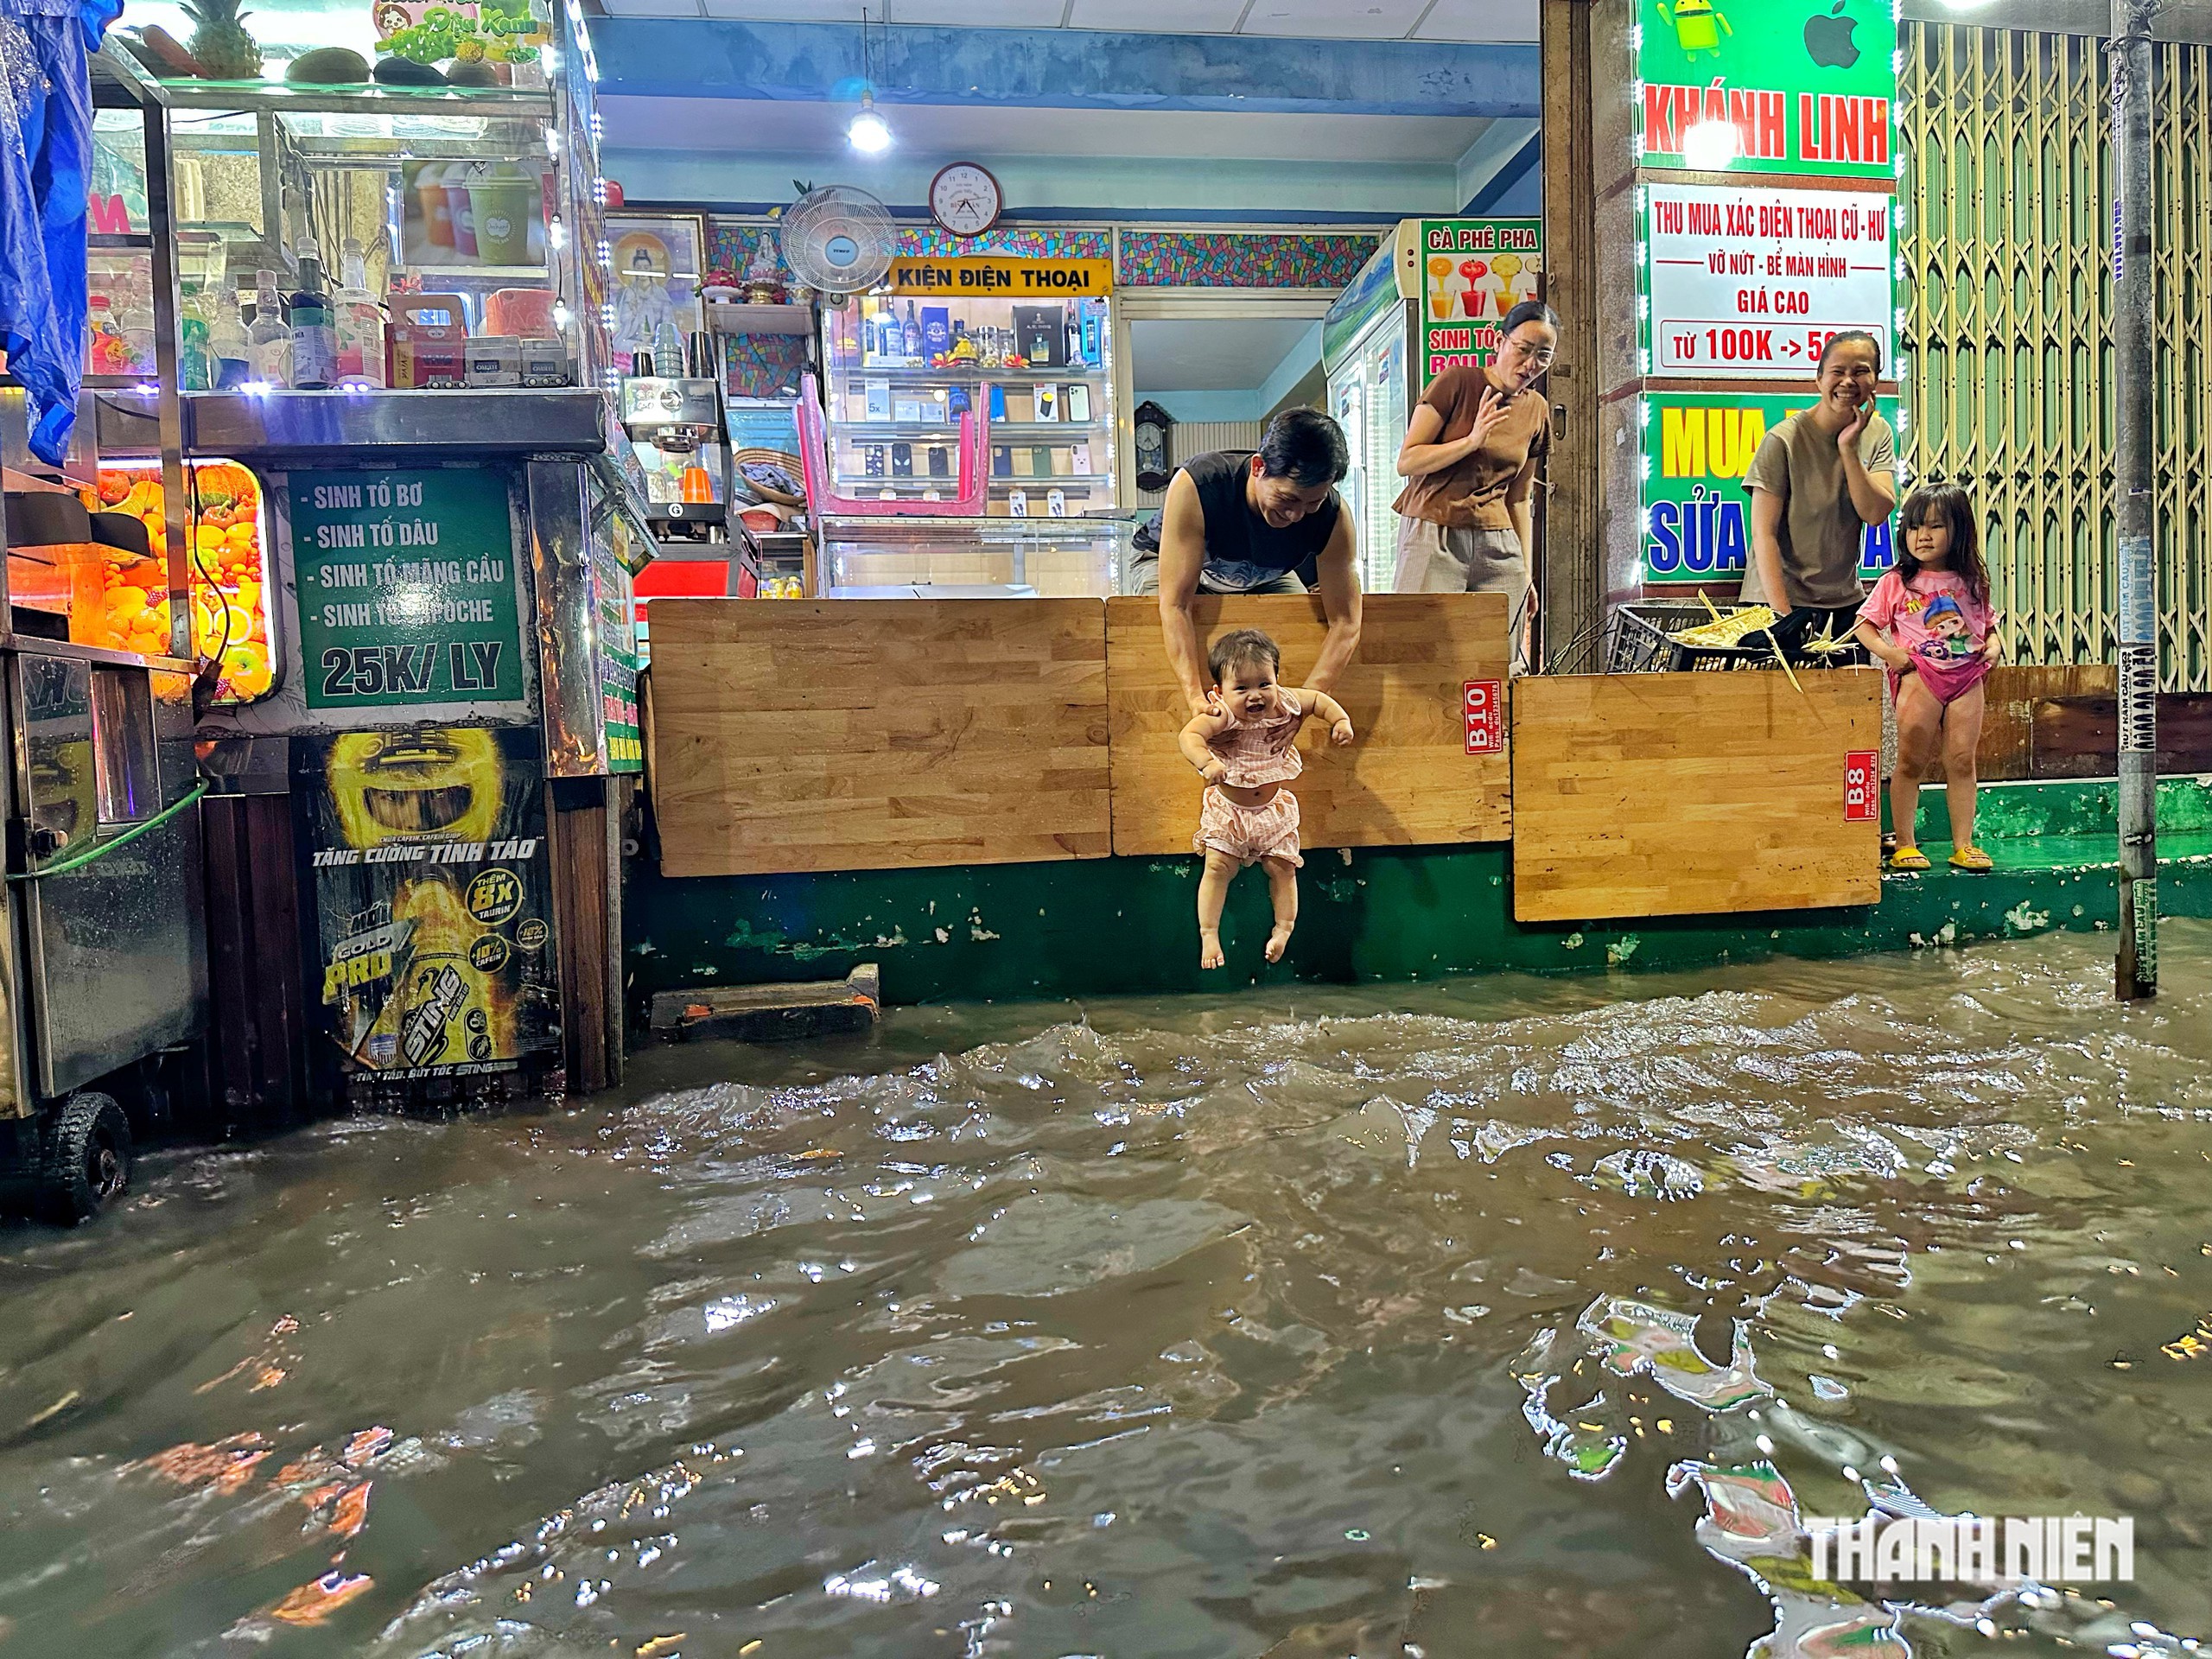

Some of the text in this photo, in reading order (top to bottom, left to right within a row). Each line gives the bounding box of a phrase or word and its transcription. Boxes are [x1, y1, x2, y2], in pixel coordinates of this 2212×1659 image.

[481, 8, 538, 37] Xanh
[1643, 76, 1890, 166] KHÁNH LINH
[1655, 198, 1885, 245] THU MUA XÁC ĐIỆN THOẠI CŨ HƯ
[1428, 226, 1538, 250] CÀ PHÊ PHA
[1708, 247, 1847, 277] VỠ NỨT BỂ MÀN HÌNH
[898, 264, 951, 291] KIỆN
[959, 264, 1011, 292] ĐIỆN
[1020, 269, 1090, 292] THOẠI
[1737, 286, 1809, 314] GIÁ CAO
[1429, 321, 1496, 350] SINH TỐ
[1674, 332, 1696, 359] TỪ
[1706, 328, 1772, 360] 100K
[868, 403, 880, 413] 5x
[1661, 407, 1766, 479] MUA
[315, 477, 423, 509] SINH TỐ BƠ
[317, 515, 439, 549] SINH TỐ DÂU
[1647, 484, 1747, 574] SỬA
[321, 564, 367, 588] SINH
[372, 555, 396, 586] TỐ
[466, 552, 505, 583] CẦU
[324, 603, 371, 627] SINH
[322, 641, 503, 696] 25K/ LY
[1467, 689, 1487, 747] B10
[1848, 768, 1865, 804] B8
[313, 836, 537, 867] TĂNG CƯỜNG TỈNH TÁO
[472, 880, 515, 912] 8X
[476, 874, 506, 887] THÊM
[480, 905, 511, 918] TAURIN
[338, 936, 392, 958] GOLD
[476, 954, 501, 967] CAFEIN
[405, 969, 461, 1062] STING
[433, 1064, 454, 1076] TỐC
[456, 1063, 493, 1076] STING
